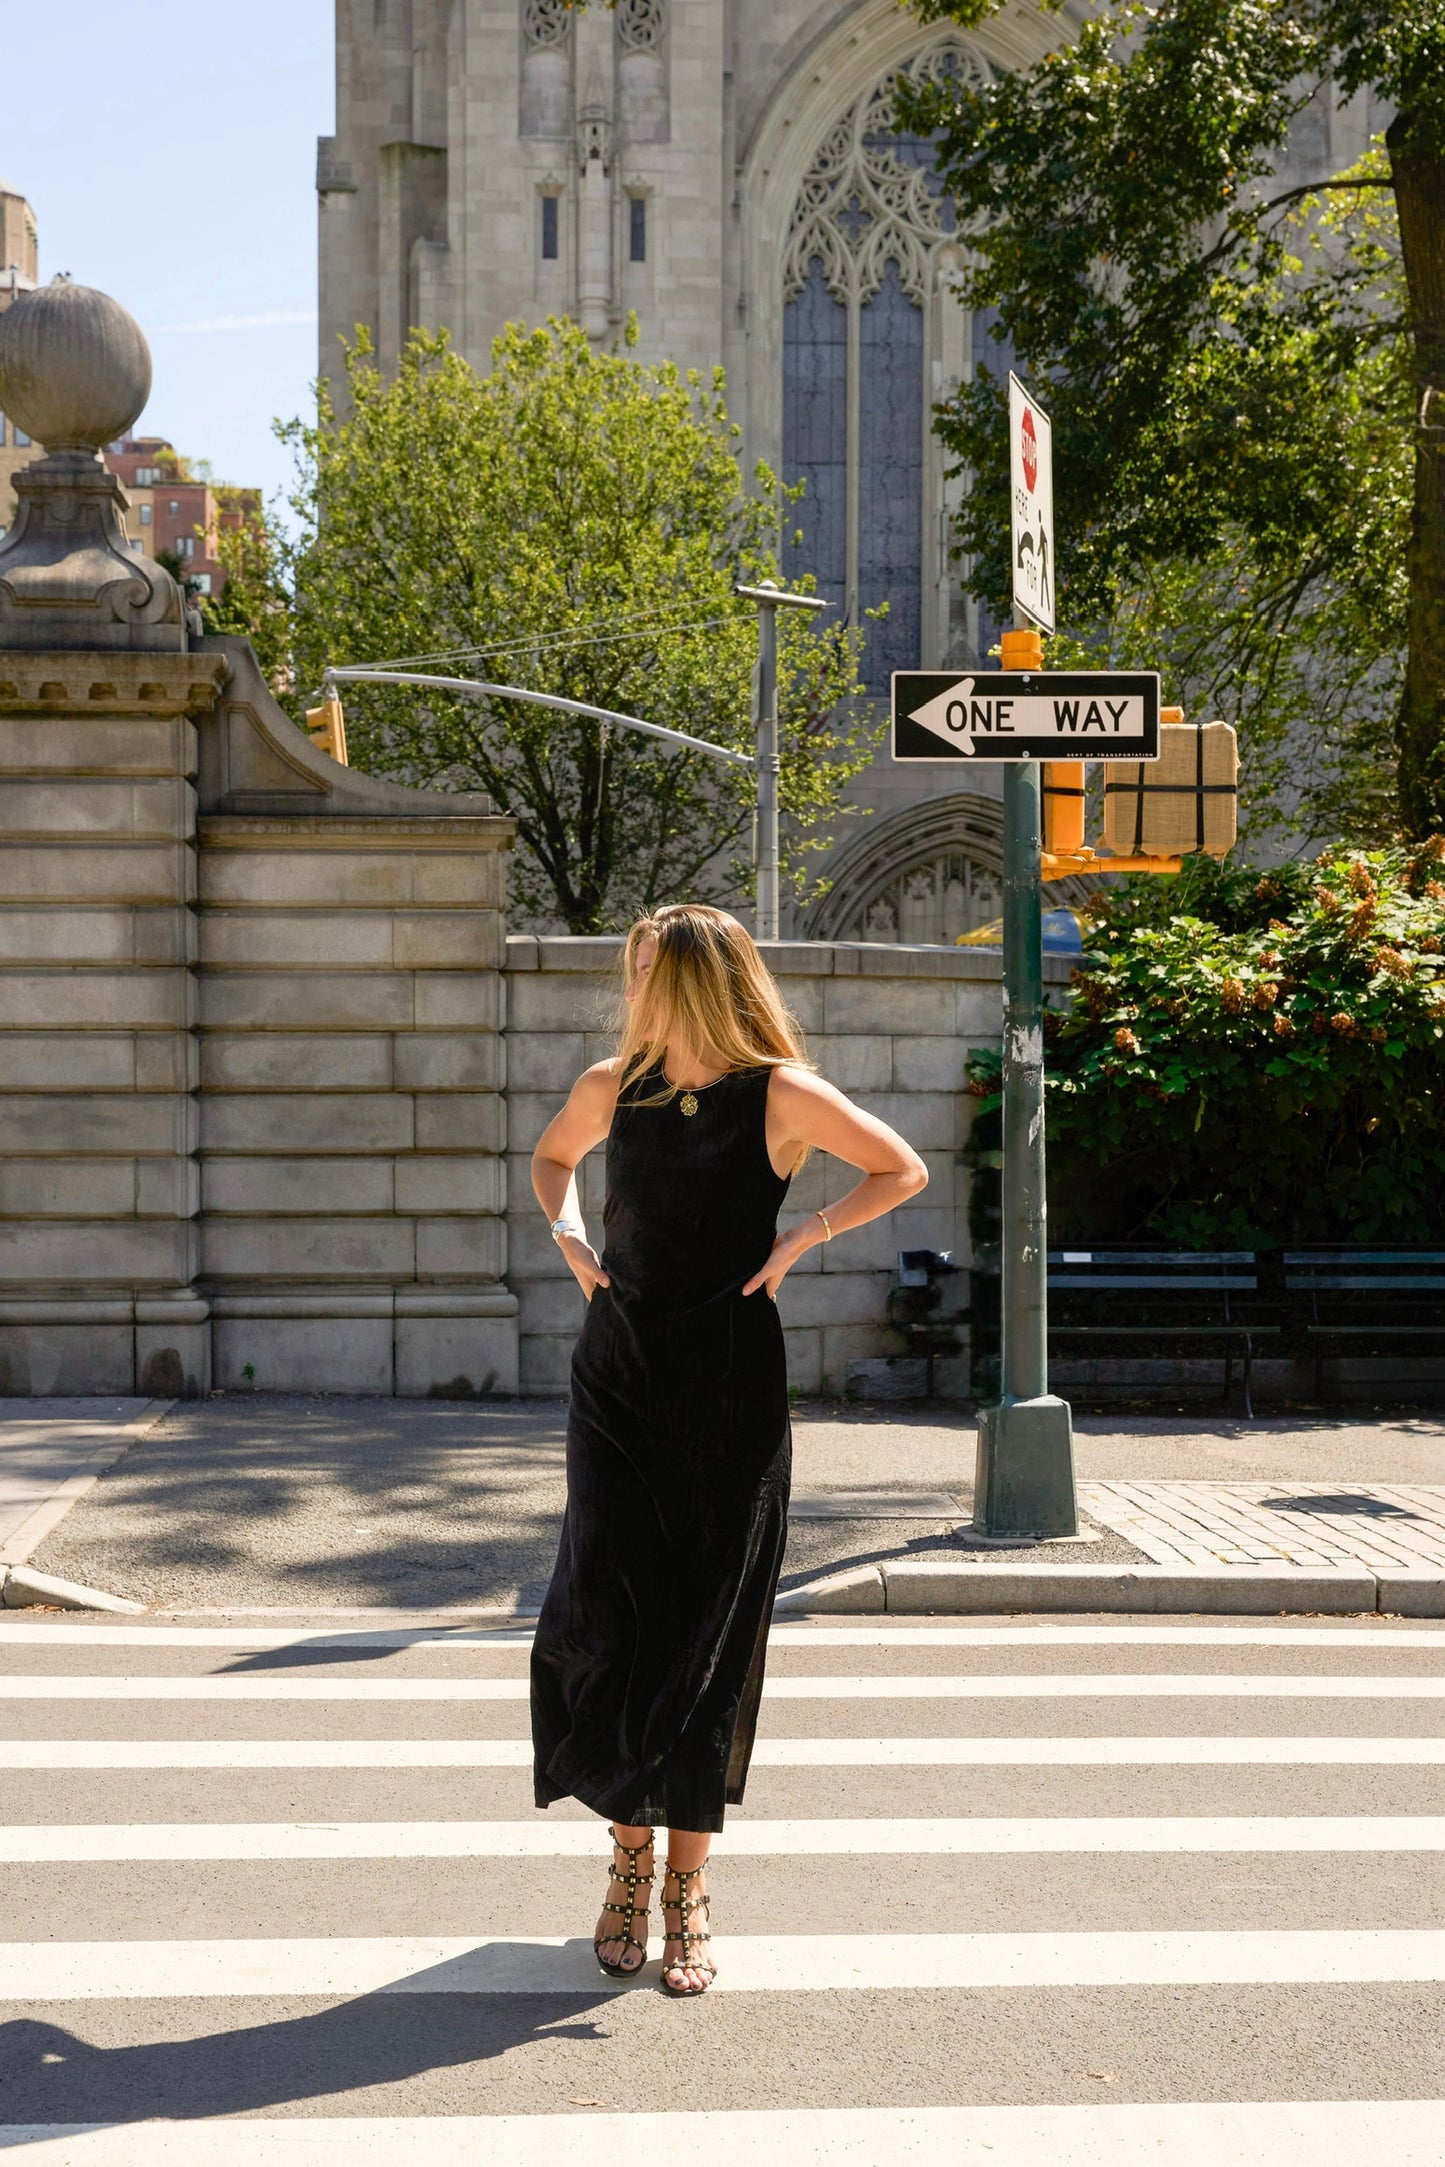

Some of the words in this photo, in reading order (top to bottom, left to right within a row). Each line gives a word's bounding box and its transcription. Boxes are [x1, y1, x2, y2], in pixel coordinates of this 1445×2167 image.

[1021, 428, 1037, 469] STOP
[1014, 484, 1029, 523] HERE
[1026, 559, 1037, 593] FOR
[945, 700, 1015, 732] ONE
[1053, 700, 1129, 732] WAY
